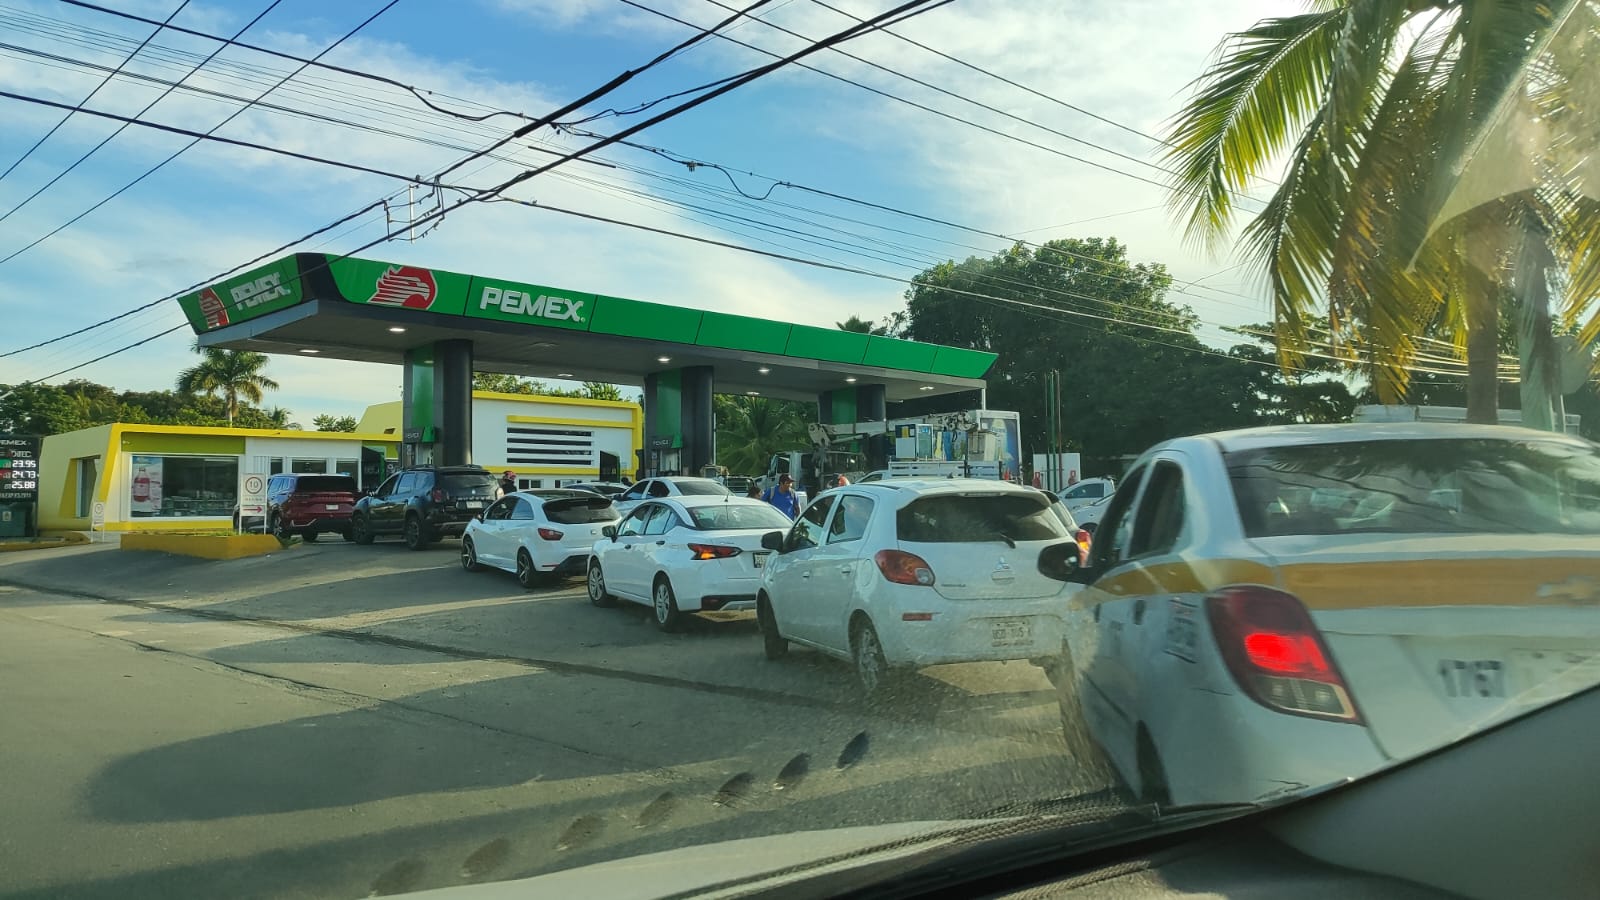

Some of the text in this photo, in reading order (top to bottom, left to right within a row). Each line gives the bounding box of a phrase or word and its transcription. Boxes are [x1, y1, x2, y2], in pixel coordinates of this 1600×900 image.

[230, 272, 288, 311] PEMEX
[480, 286, 584, 322] PEMEX
[12, 460, 37, 468] 23.95
[12, 470, 36, 479] 24.73
[11, 481, 36, 489] 25.88
